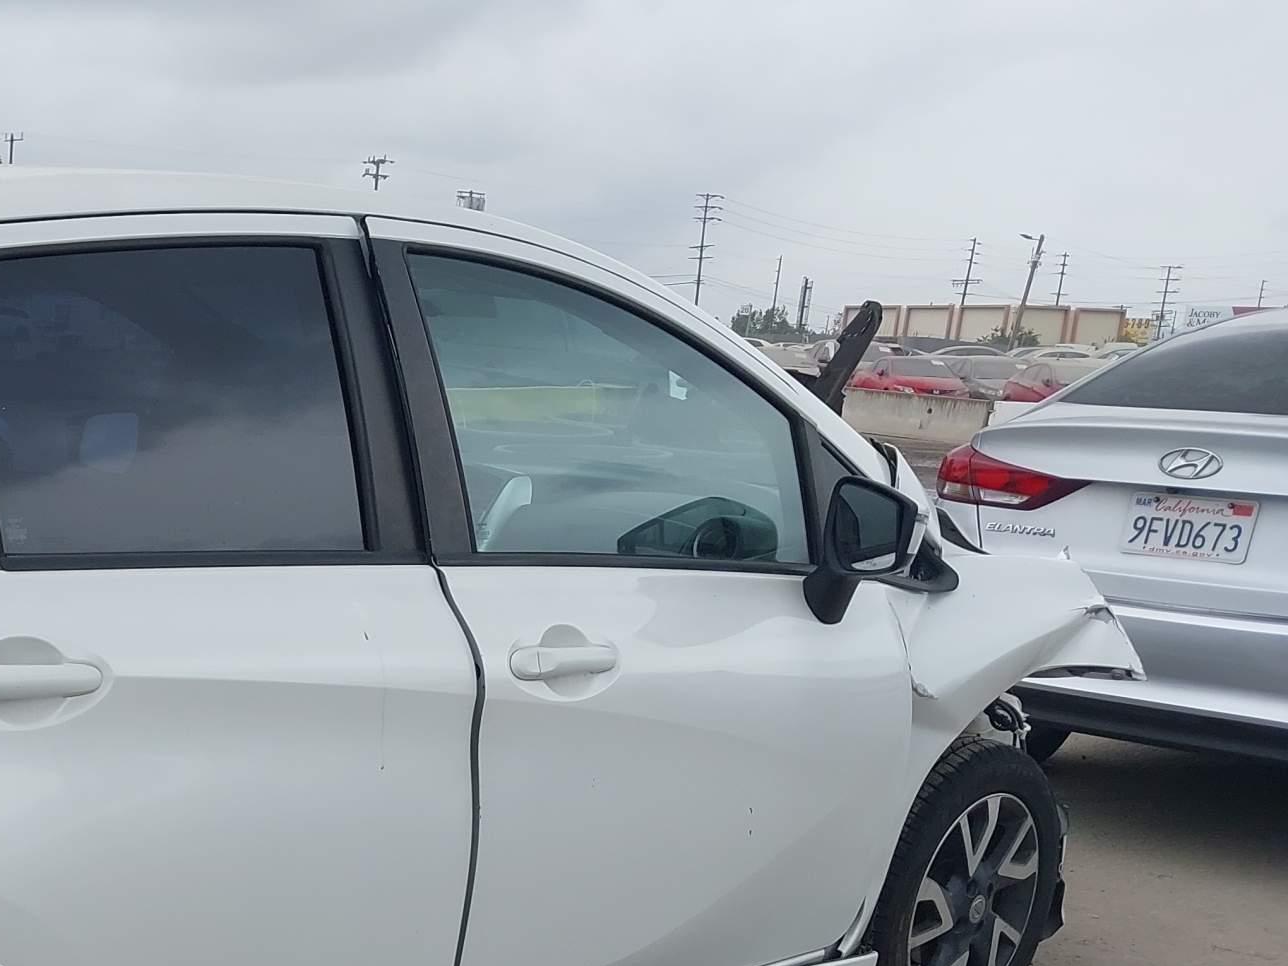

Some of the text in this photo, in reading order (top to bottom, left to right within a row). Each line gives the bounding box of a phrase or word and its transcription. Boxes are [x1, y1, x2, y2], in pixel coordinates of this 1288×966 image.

[1188, 308, 1221, 319] JACOBY
[1154, 497, 1232, 518] California
[985, 522, 1056, 539] ELANTRA
[1128, 515, 1243, 553] 9FVD673
